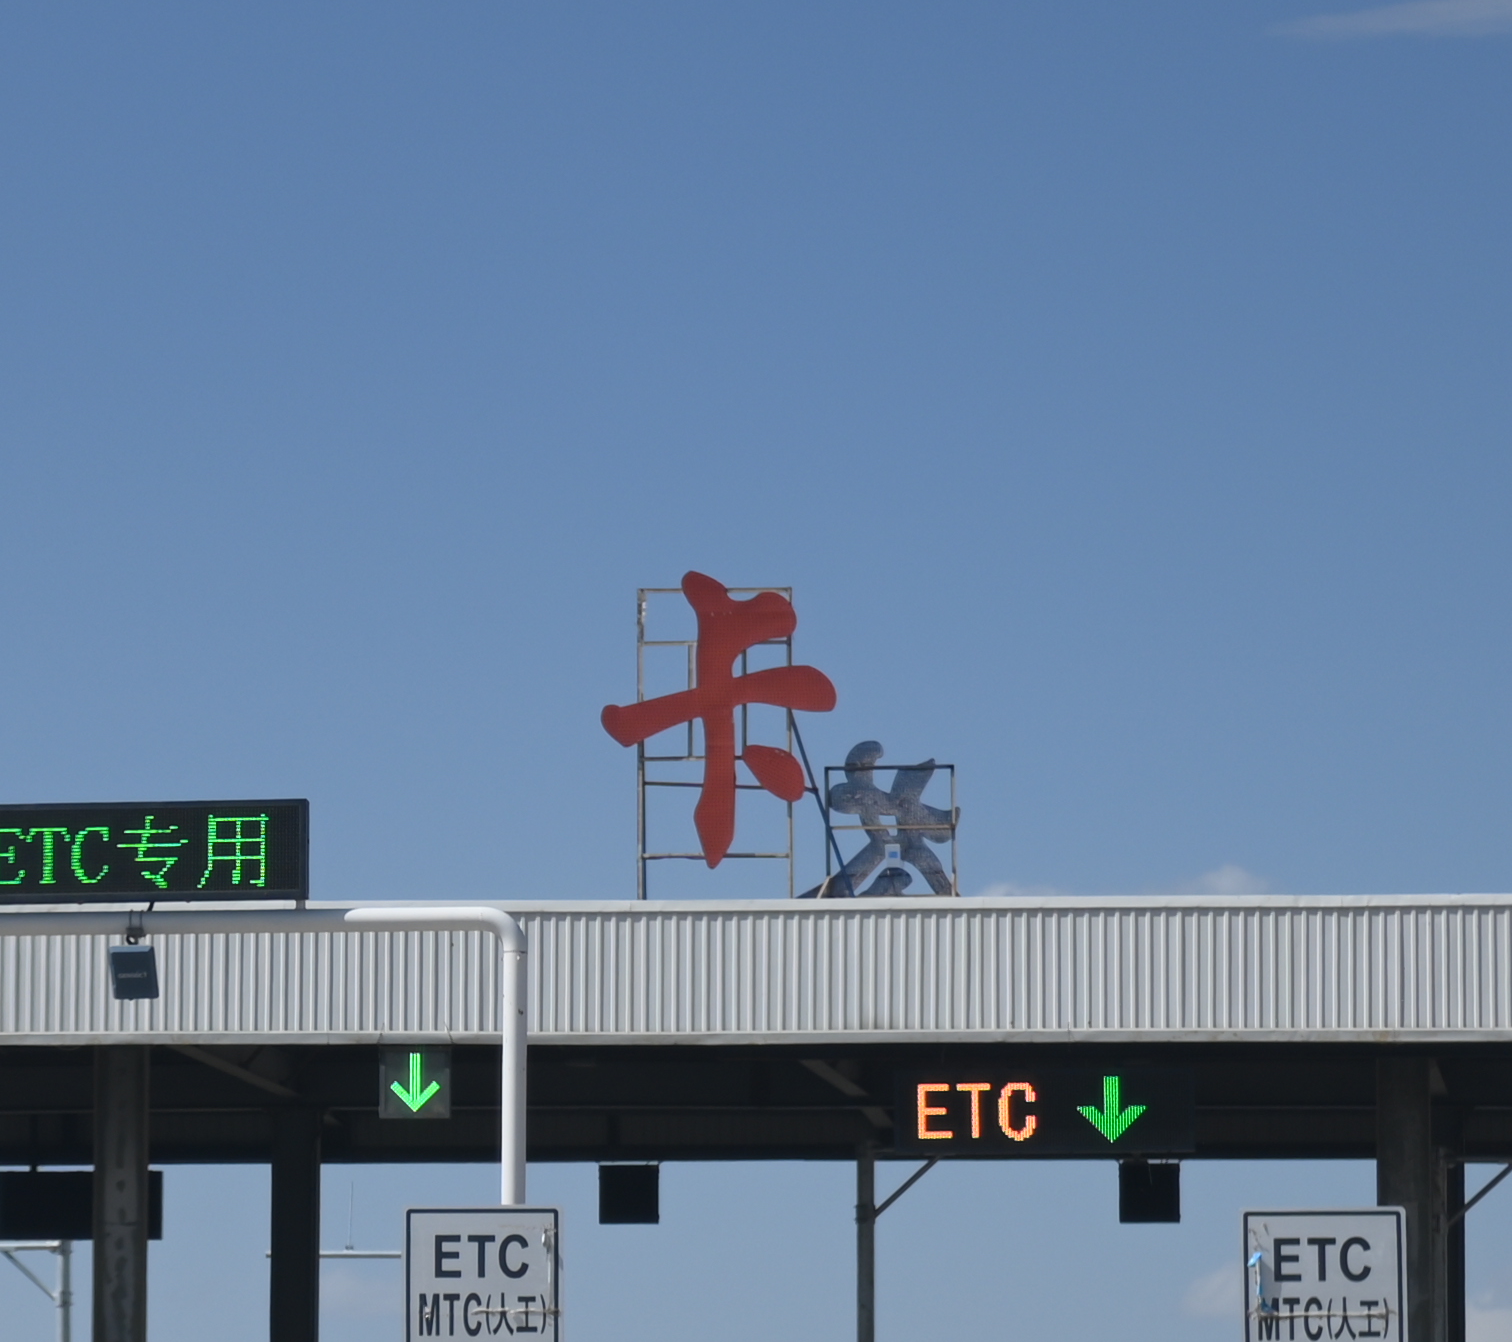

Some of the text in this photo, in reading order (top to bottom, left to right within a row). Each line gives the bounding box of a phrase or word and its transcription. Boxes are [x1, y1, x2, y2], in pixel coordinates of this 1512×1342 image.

[601, 570, 836, 869] 卡
[916, 1080, 1038, 1142] ETC
[435, 1234, 529, 1279] ETC
[1273, 1237, 1372, 1283] ETC
